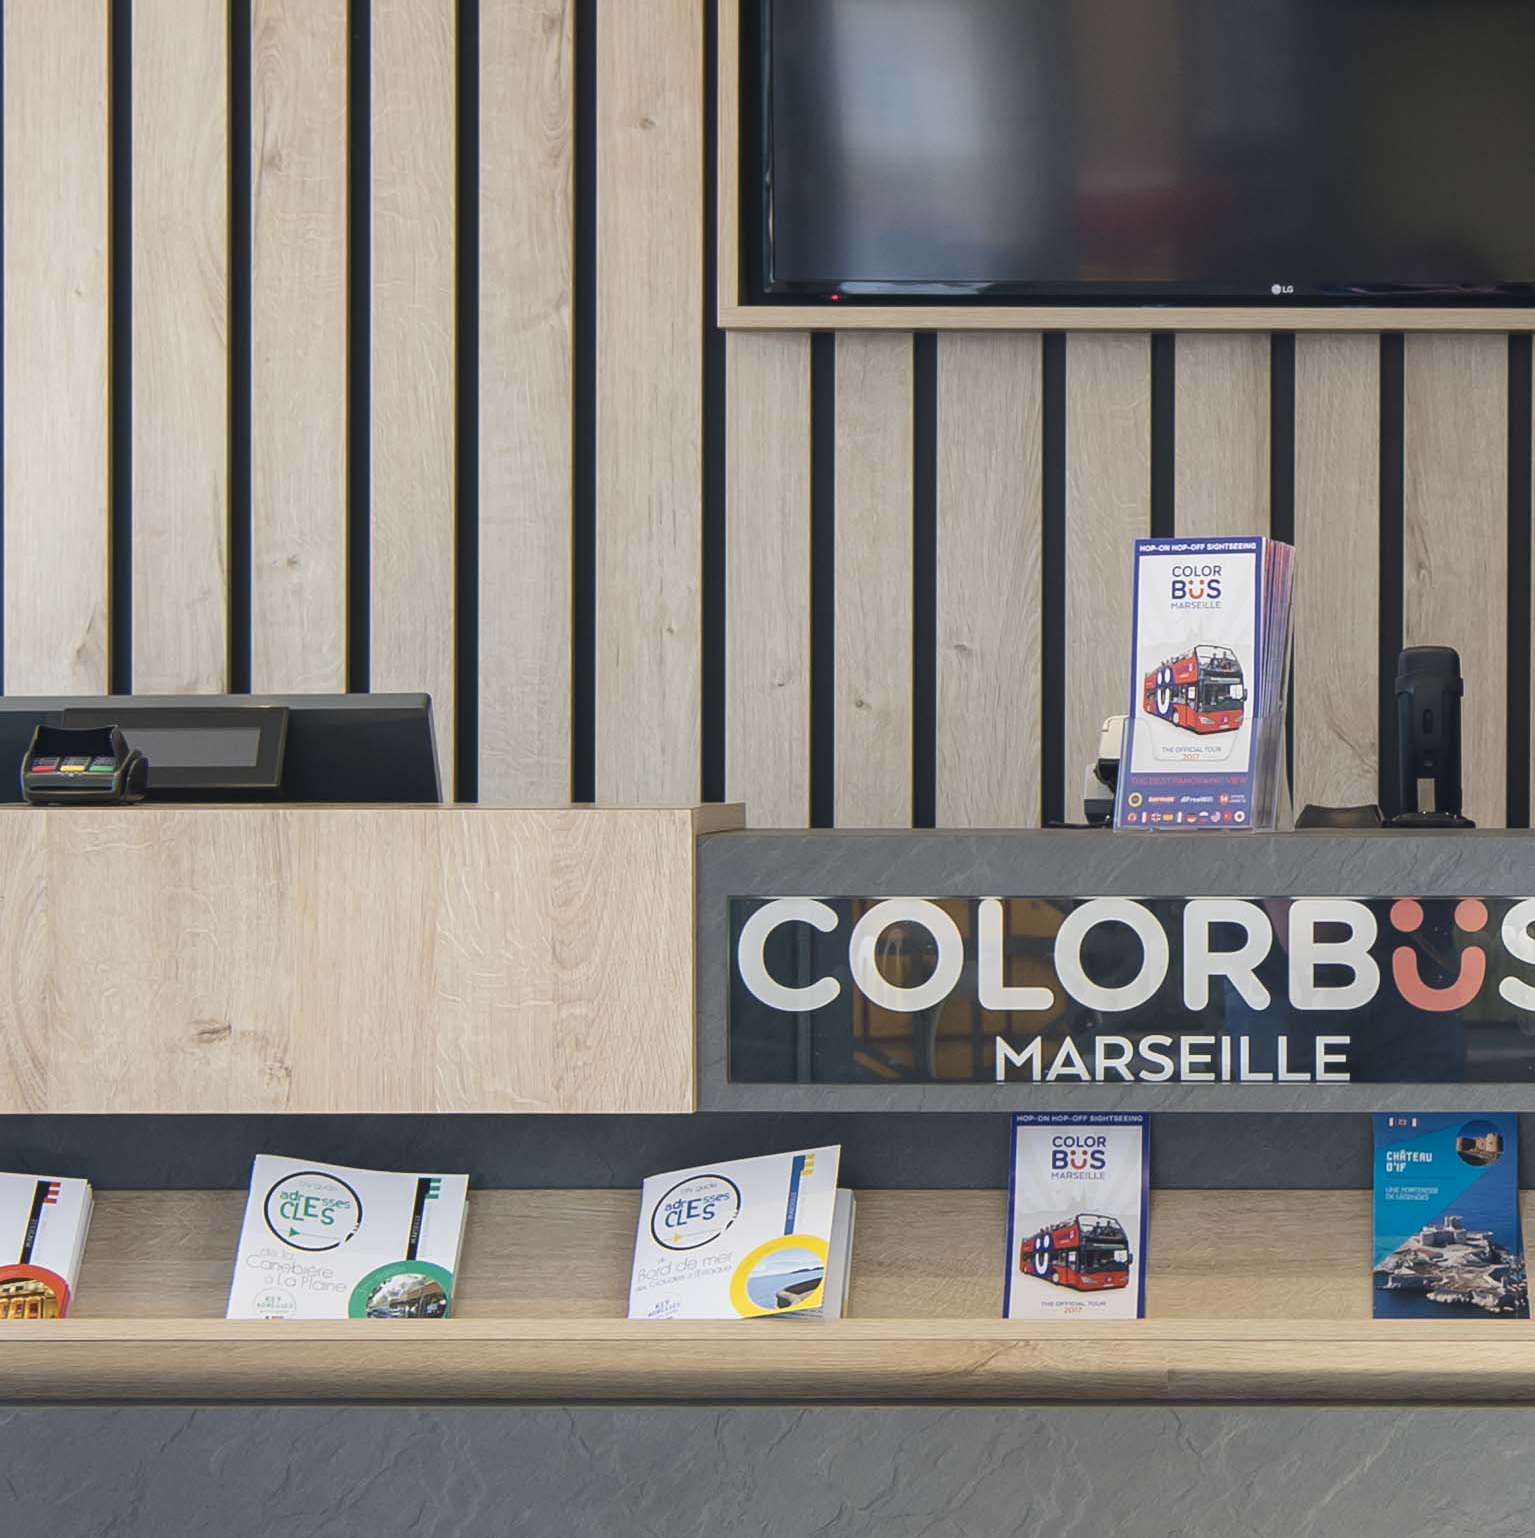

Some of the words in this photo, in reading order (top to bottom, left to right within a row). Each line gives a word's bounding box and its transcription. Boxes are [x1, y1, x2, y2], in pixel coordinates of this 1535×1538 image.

[1139, 544, 1170, 552] HOP-ON
[1171, 543, 1205, 551] HOP-OFF
[1206, 542, 1257, 550] SIGHTSEEING
[1171, 565, 1222, 578] COLOR
[1170, 601, 1222, 610] MARSEILLE
[995, 1035, 1351, 1082] MARSEILLE
[1016, 1114, 1050, 1122] HOP-ON
[1052, 1114, 1088, 1122] HOP-OFF
[1090, 1114, 1144, 1122] SIGHTSEEING
[1052, 1136, 1107, 1148] COLOR
[1051, 1171, 1105, 1180] MARSEILLE
